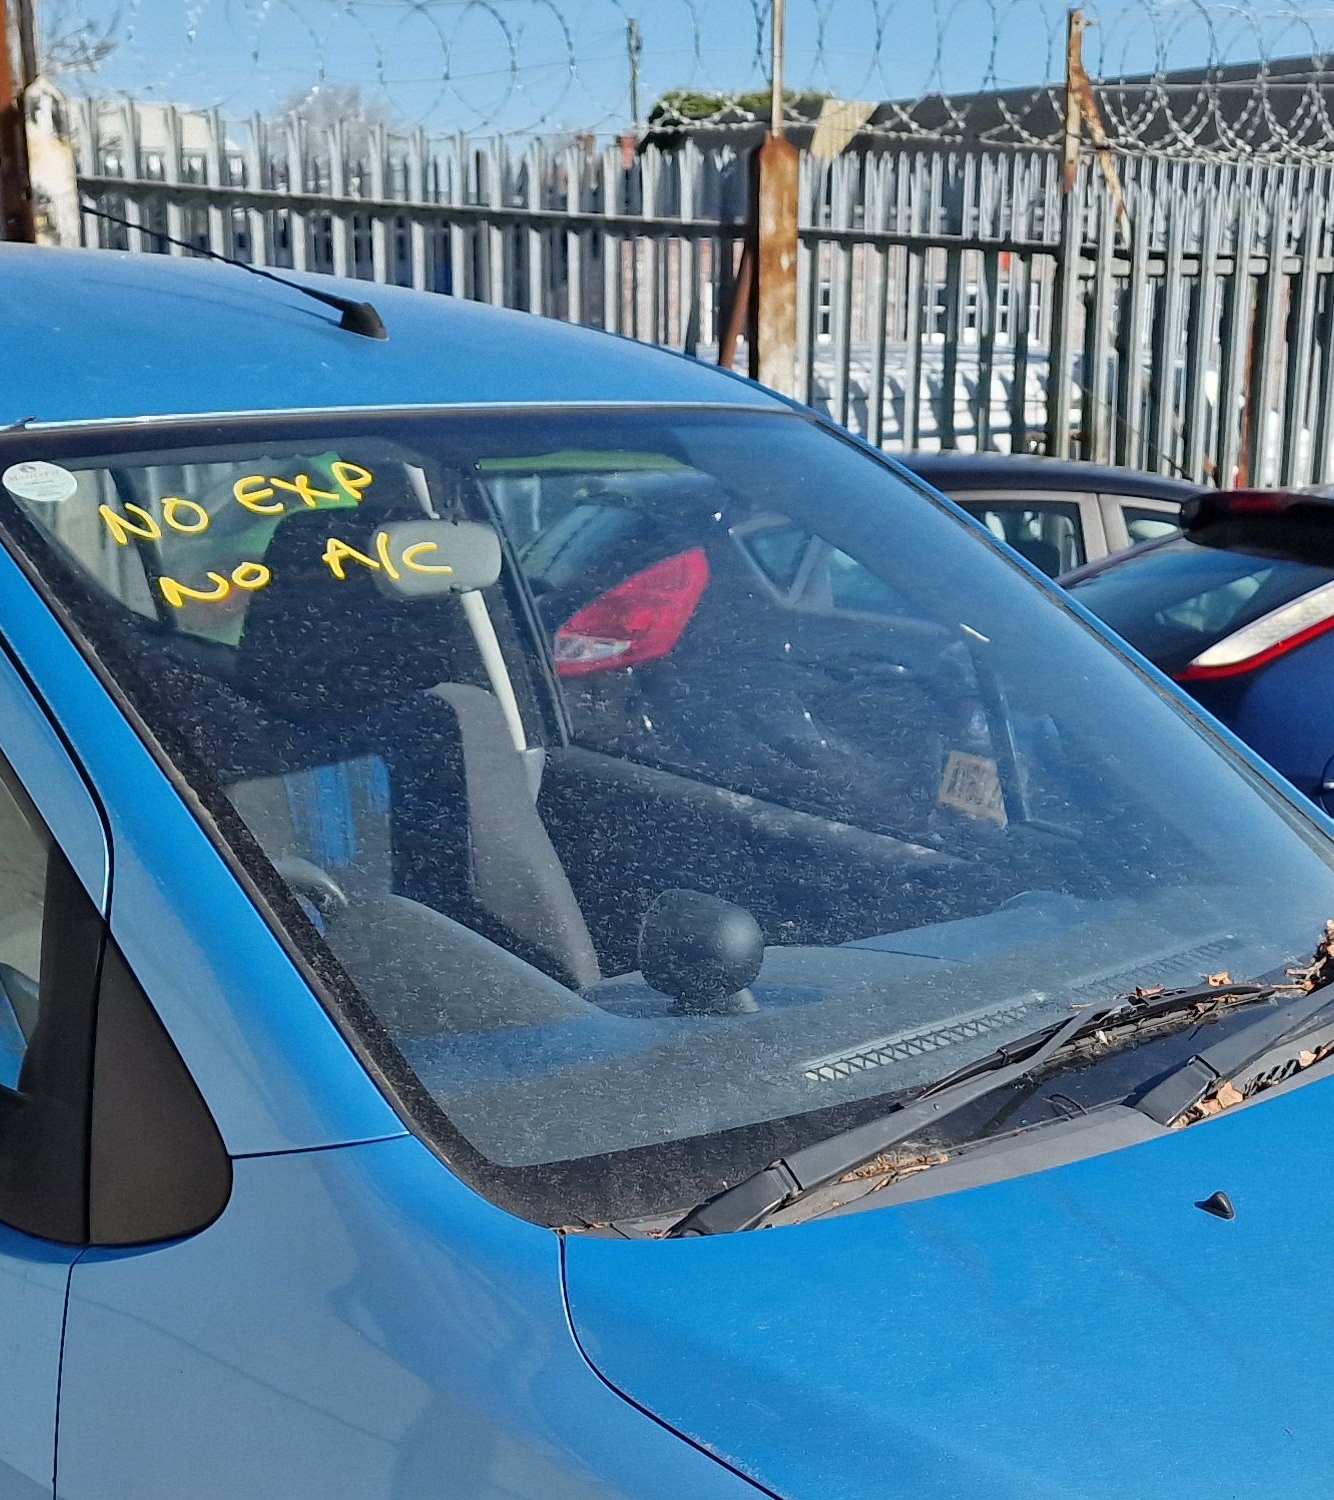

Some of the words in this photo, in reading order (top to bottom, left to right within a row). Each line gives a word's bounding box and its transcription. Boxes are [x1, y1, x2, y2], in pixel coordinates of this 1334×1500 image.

[98, 497, 208, 546] NO
[233, 461, 373, 515] EXP
[322, 532, 452, 580] A/C
